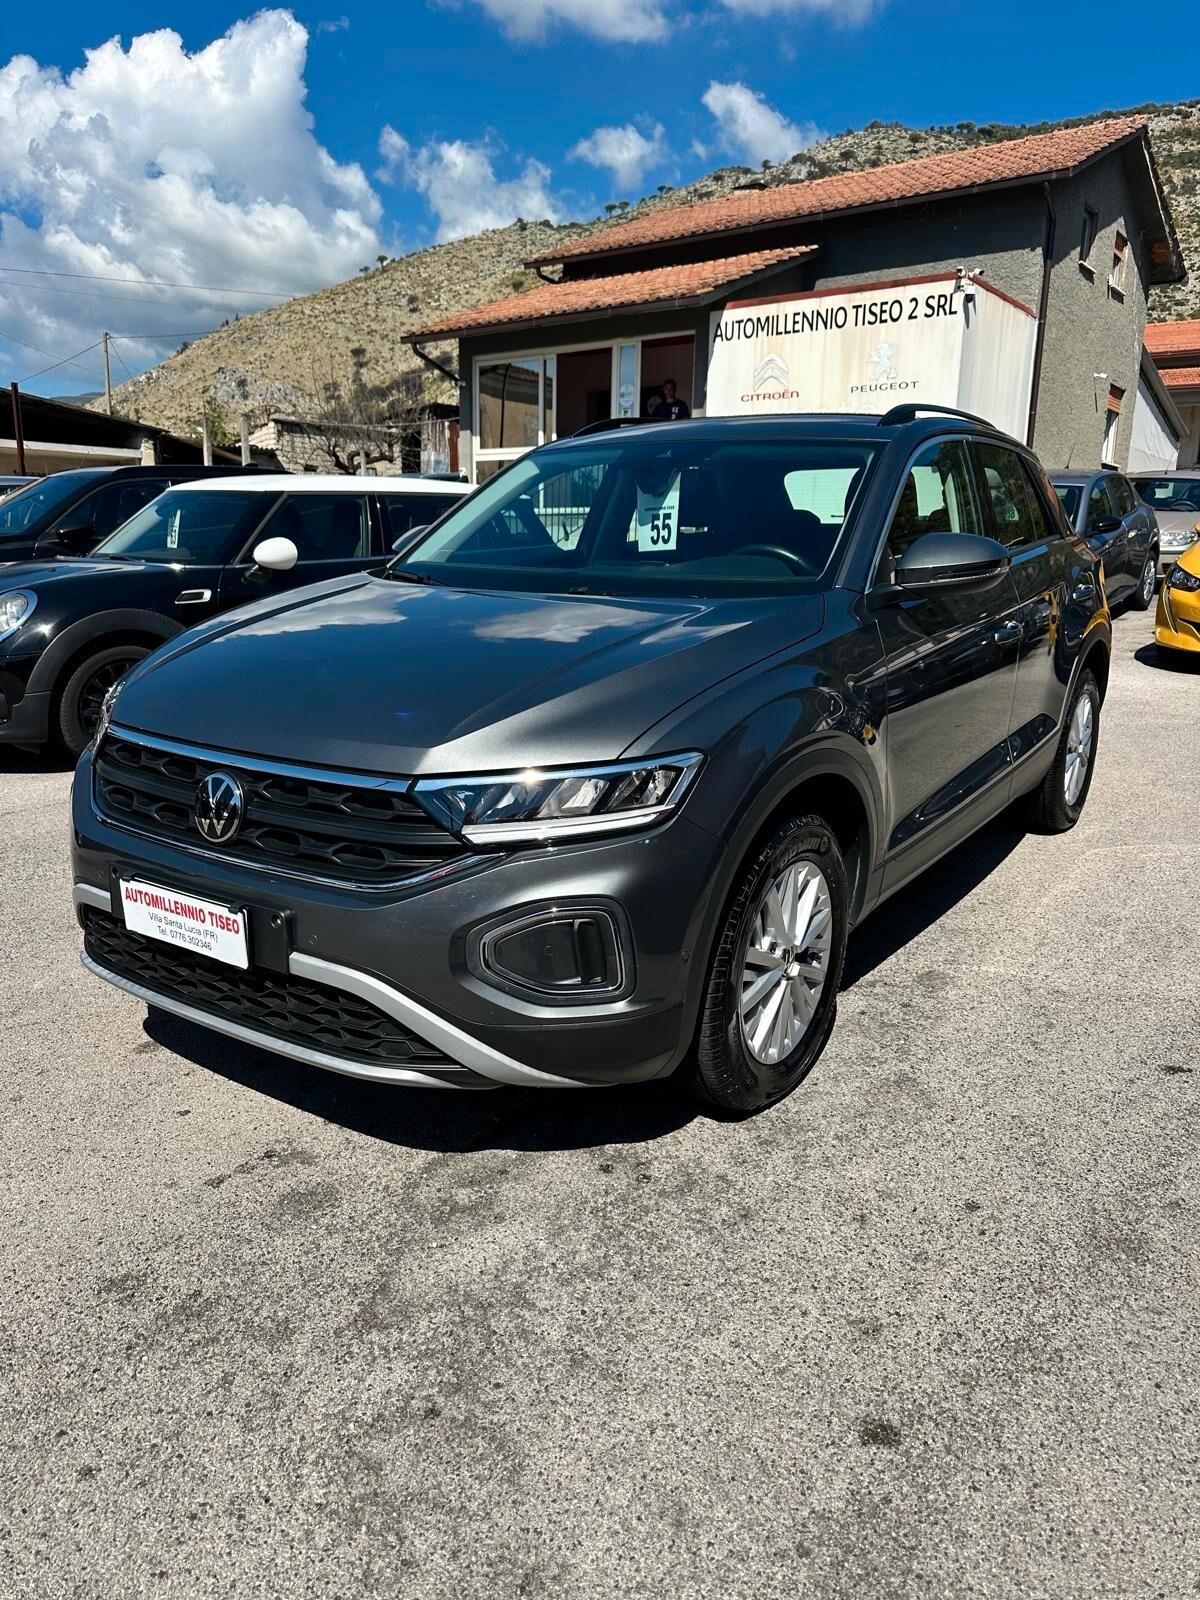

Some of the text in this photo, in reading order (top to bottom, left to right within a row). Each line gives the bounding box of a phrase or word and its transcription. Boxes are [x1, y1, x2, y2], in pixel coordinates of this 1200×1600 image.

[713, 293, 958, 343] AUTOMILLENNIO TISEO 2 SRL
[850, 381, 919, 394] PEUGEOT
[650, 512, 672, 545] 55
[124, 886, 240, 935] AUTOMILLENNIO TISEO
[149, 912, 219, 943] Villa Santa Lucia (FR)
[157, 926, 169, 937] Tel.
